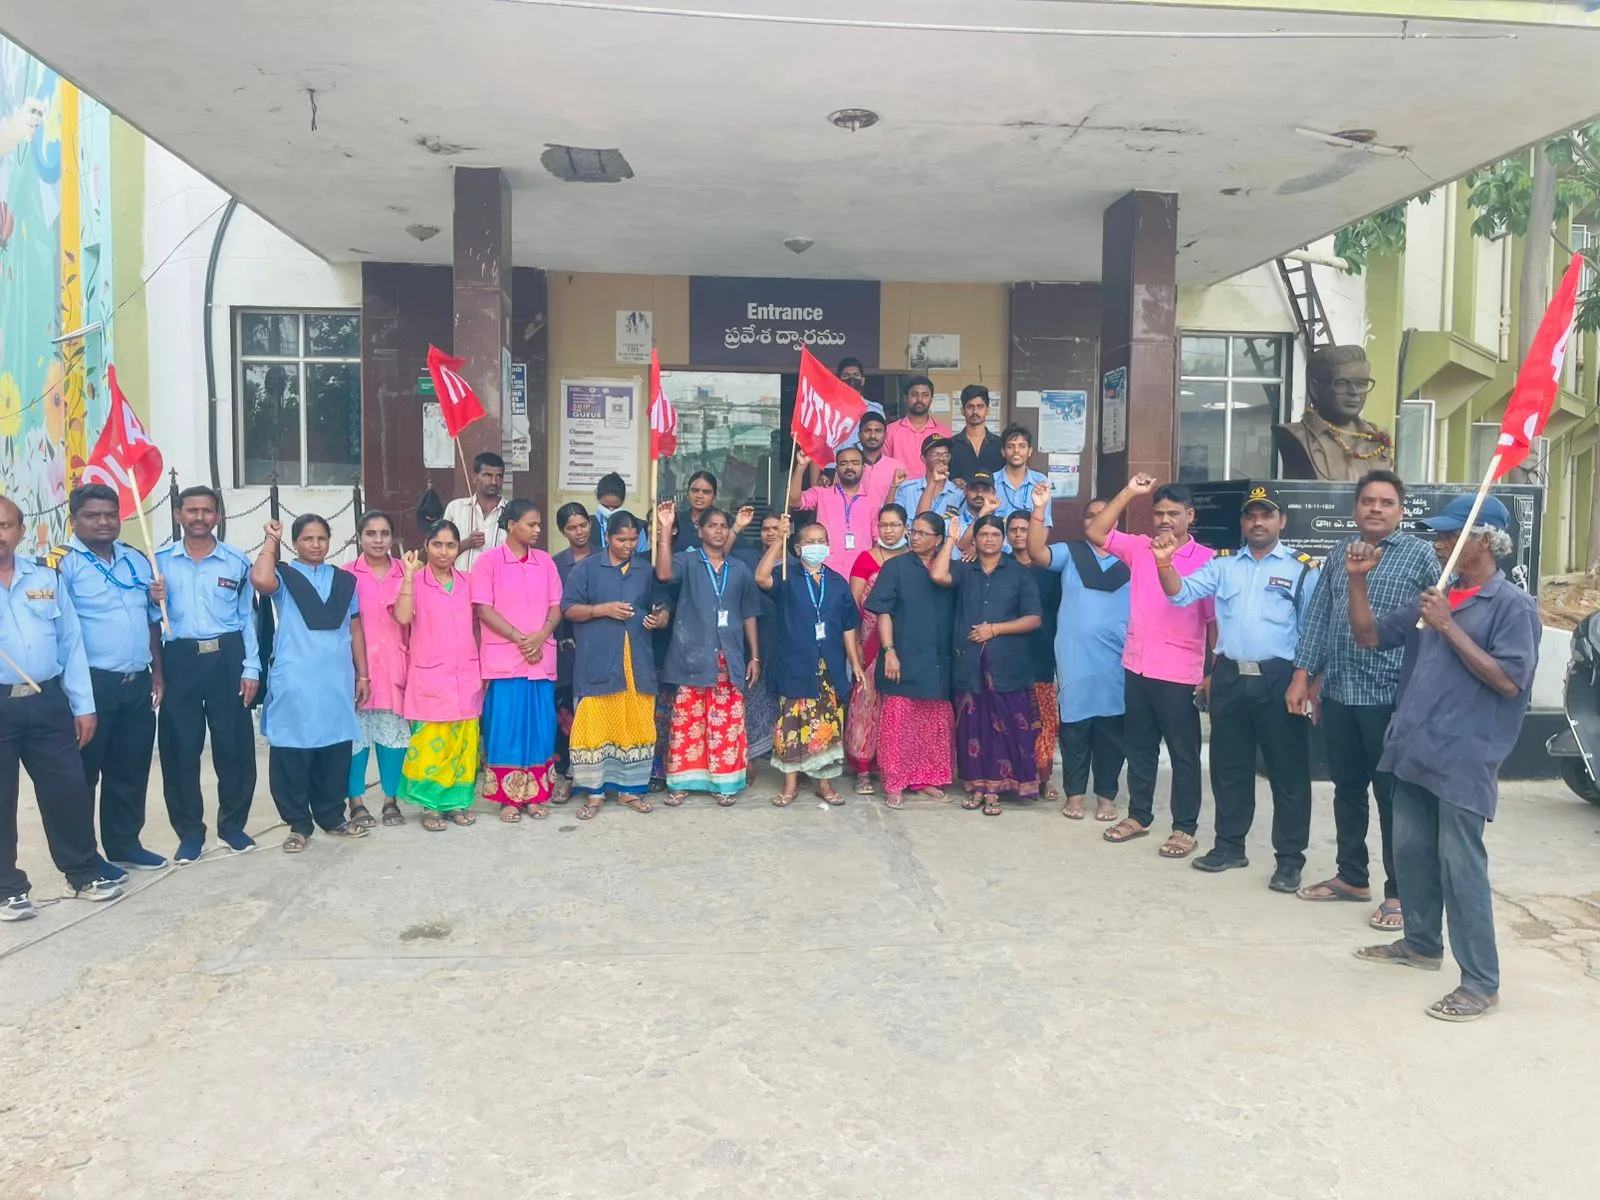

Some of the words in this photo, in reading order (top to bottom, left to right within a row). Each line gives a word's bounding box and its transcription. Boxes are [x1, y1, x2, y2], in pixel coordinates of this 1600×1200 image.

[747, 302, 823, 321] Entrance
[724, 323, 772, 349] ప్రవేశ
[775, 328, 846, 351] ద్వారము
[801, 376, 854, 448] AITUC
